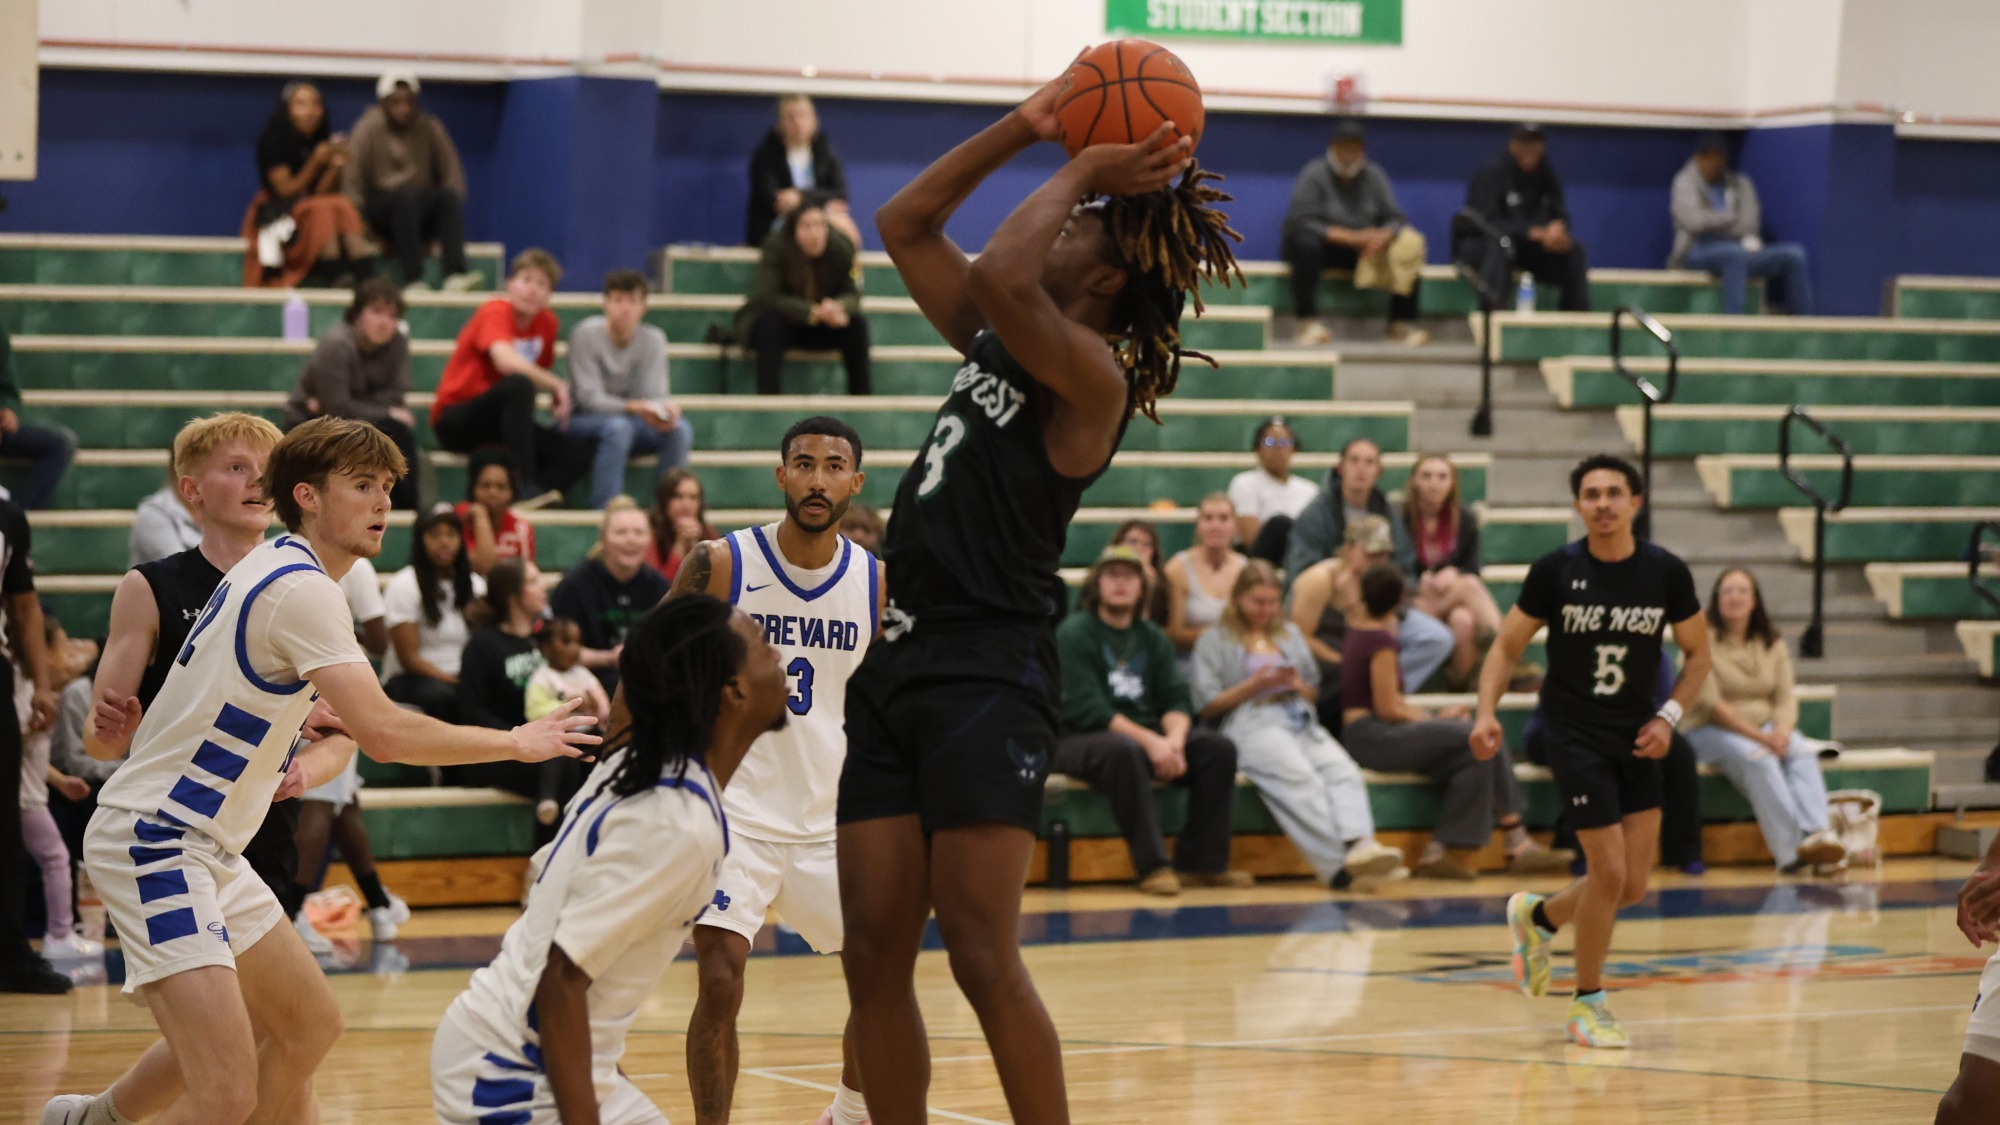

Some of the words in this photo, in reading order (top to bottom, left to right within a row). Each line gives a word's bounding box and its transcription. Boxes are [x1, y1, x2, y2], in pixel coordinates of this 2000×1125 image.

[1145, 0, 1257, 34] STUDENT
[1260, 0, 1364, 37] SECTION
[916, 413, 967, 498] 3
[1561, 603, 1606, 633] THE
[1608, 605, 1665, 636] NEST
[785, 656, 815, 716] 3
[1593, 643, 1629, 695] 5
